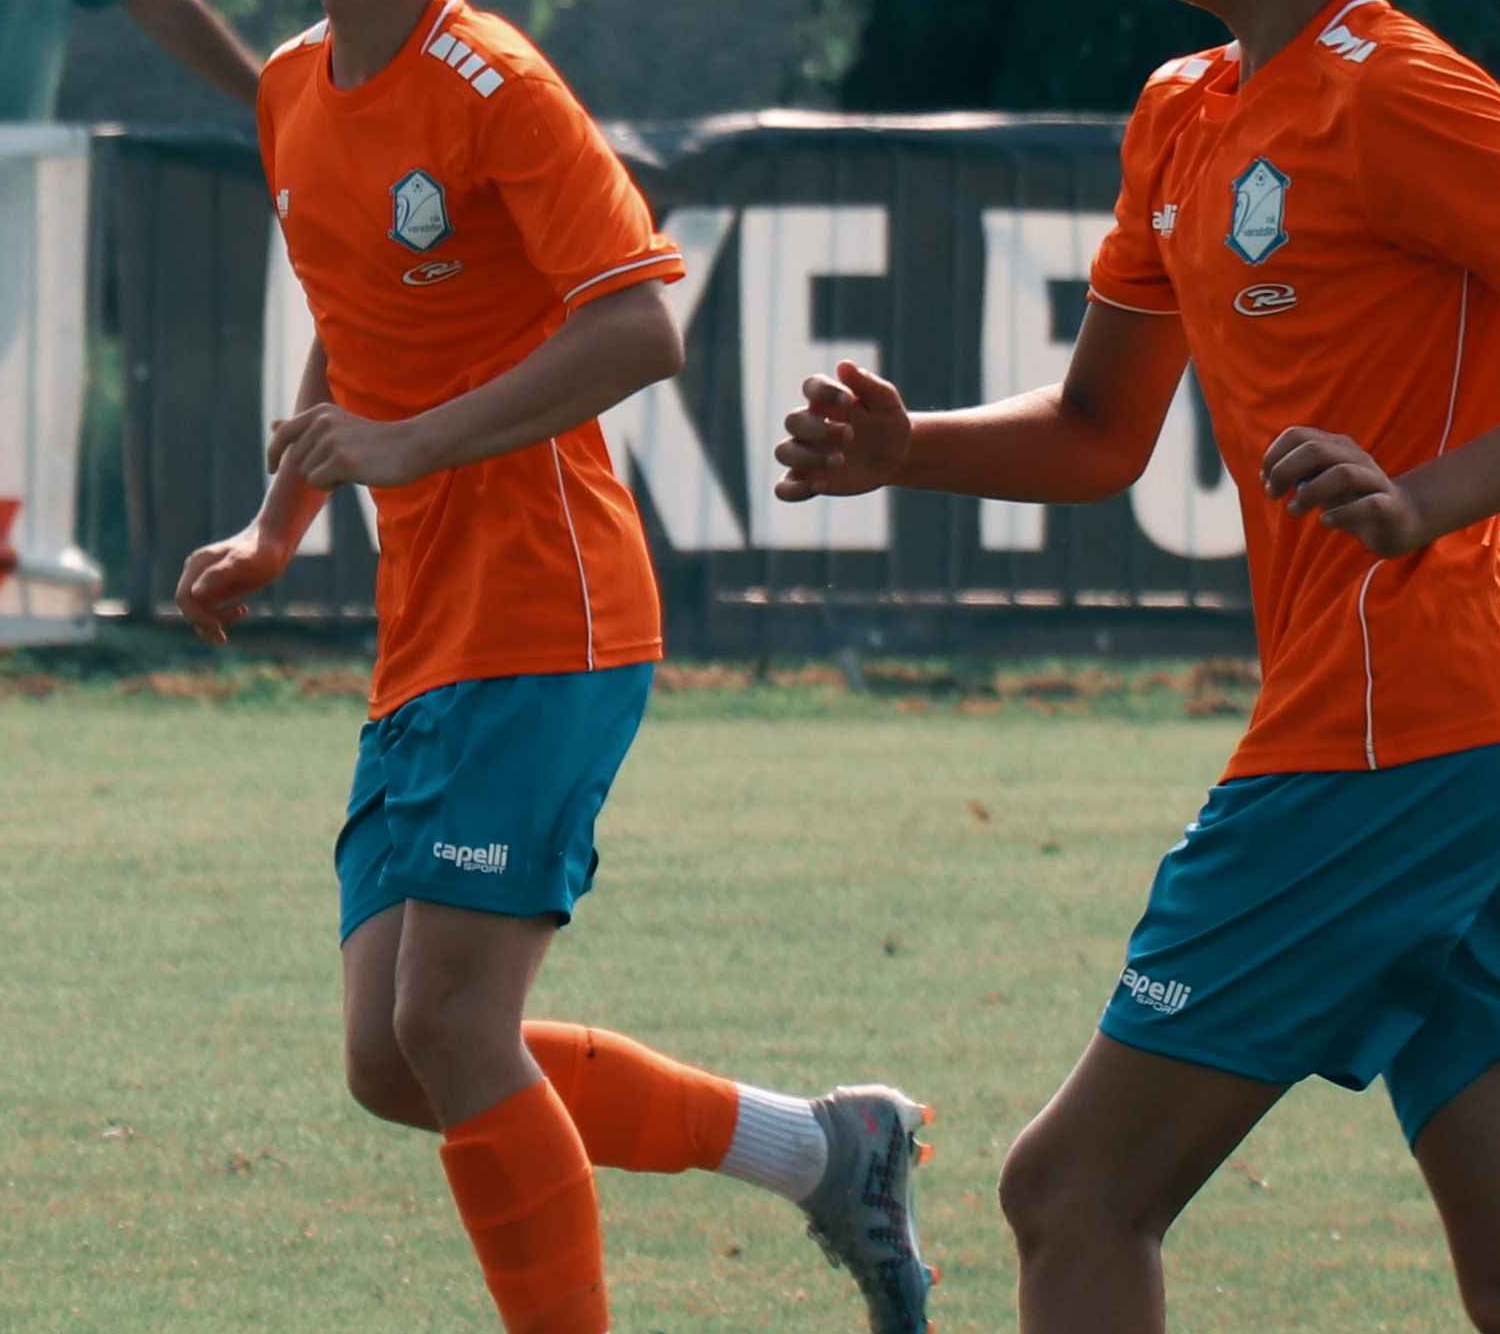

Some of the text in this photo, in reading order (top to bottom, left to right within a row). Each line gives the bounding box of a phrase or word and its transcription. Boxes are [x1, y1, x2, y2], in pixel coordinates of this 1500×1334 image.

[432, 841, 509, 868] capelli
[463, 862, 505, 874] SPORT
[1121, 967, 1192, 1011] apelli
[1136, 994, 1177, 1015] SPORT
